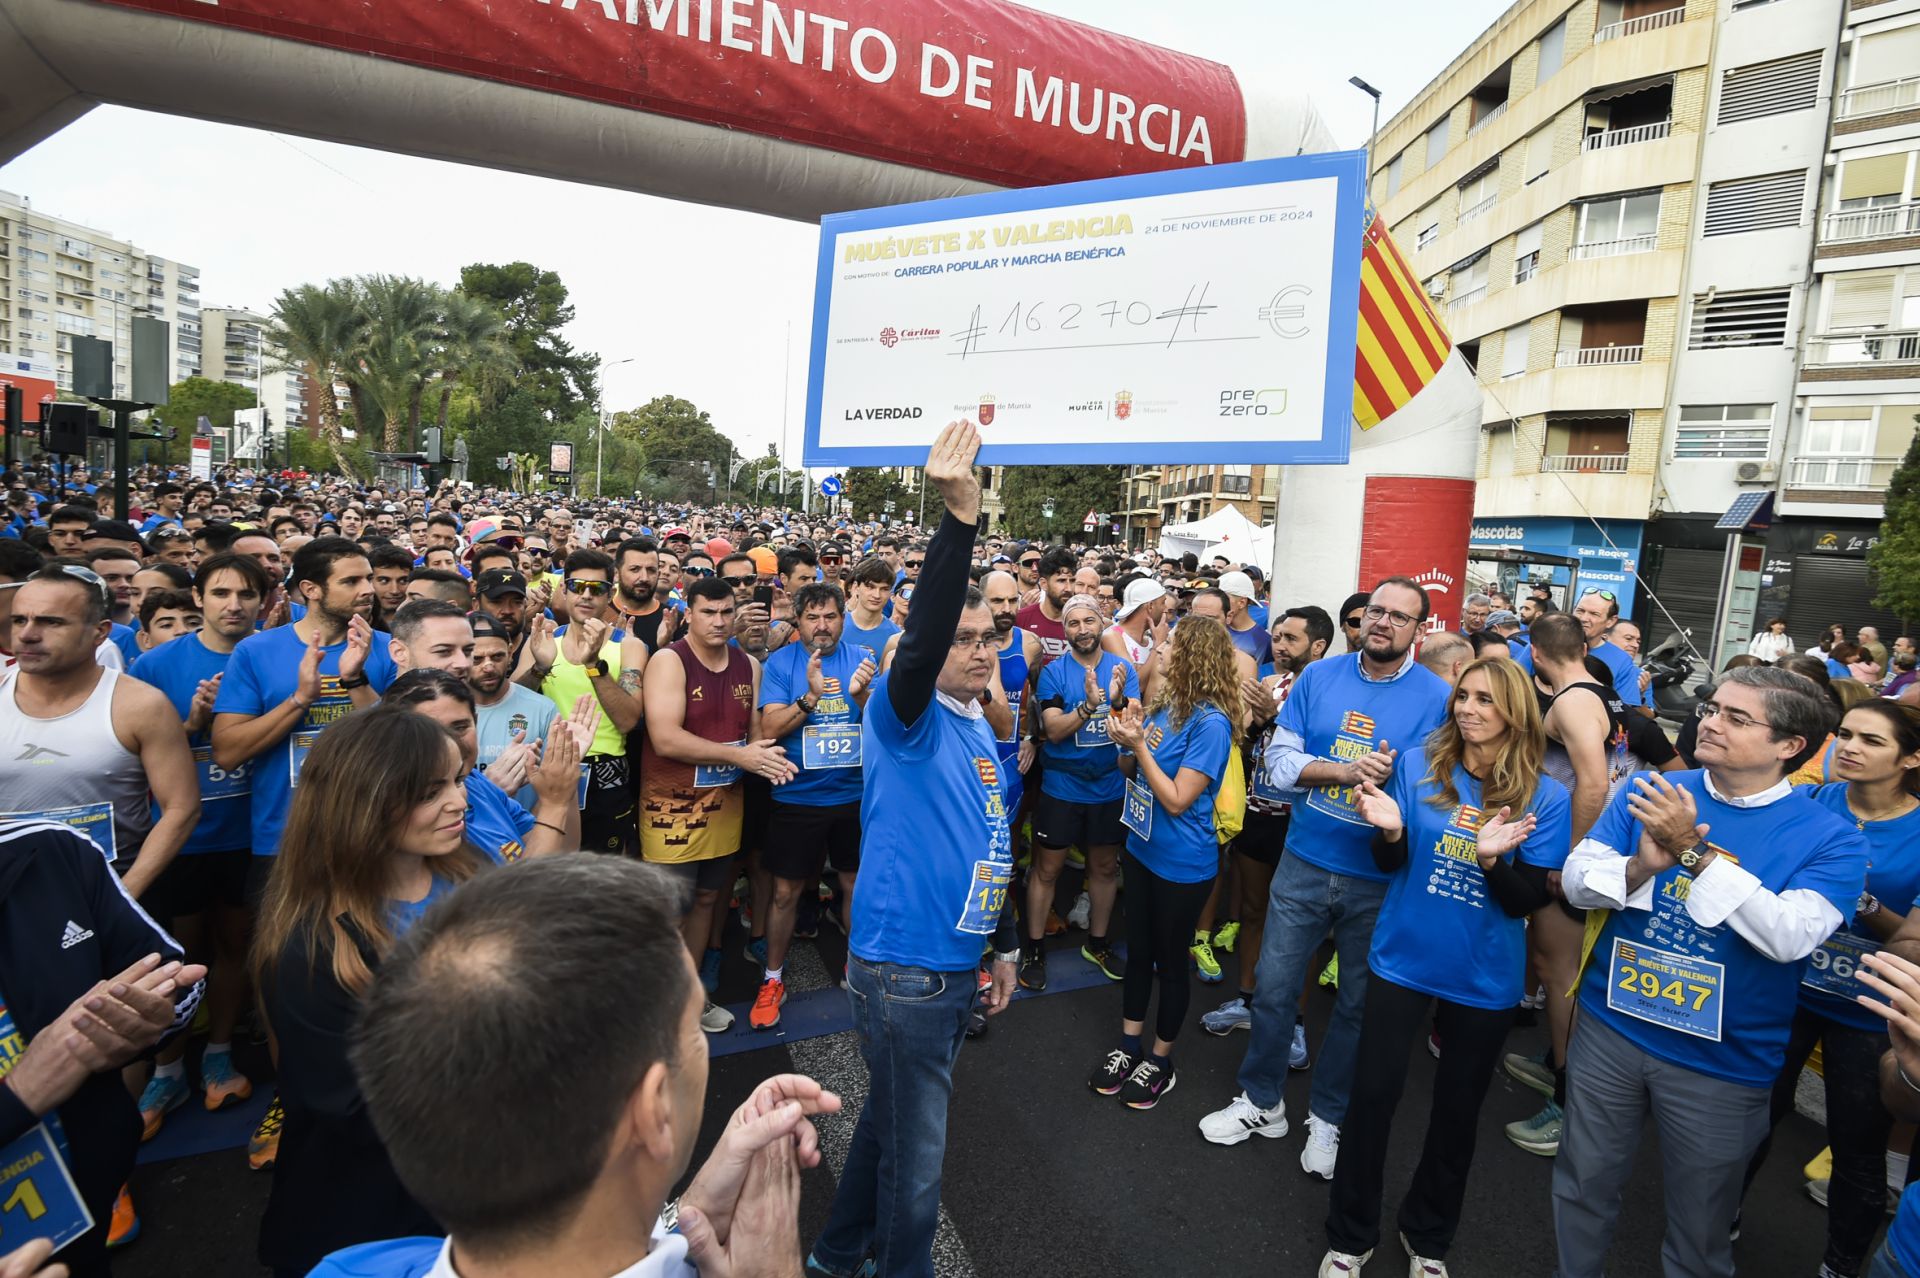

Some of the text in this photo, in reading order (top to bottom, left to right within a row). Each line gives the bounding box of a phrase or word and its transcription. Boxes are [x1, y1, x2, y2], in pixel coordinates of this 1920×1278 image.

[920, 42, 994, 110] DE
[1014, 67, 1214, 164] MURCIA
[1145, 210, 1313, 235] 24 DE NOVIEMBRE DE 2024
[844, 214, 1134, 263] MUÉVETE X VALENCIA
[894, 246, 1126, 278] CARRERA POPULAR Y MARCHA BENÉFICA
[900, 327, 941, 338] Cáritas
[1219, 390, 1255, 404] pre
[845, 407, 923, 421] LA VERDAD
[953, 404, 977, 412] Región
[1007, 402, 1032, 410] Murcia
[1219, 404, 1268, 416] zero
[1470, 525, 1524, 540] Mascotas
[1578, 548, 1629, 559] San Roque
[1577, 571, 1625, 582] Mascotas
[1085, 720, 1108, 734] 45
[815, 738, 852, 755] 192
[1257, 770, 1273, 787] 10
[1129, 797, 1146, 822] 935
[69, 813, 108, 825] VALENCIA
[1441, 833, 1478, 853] MUÉVE
[1433, 841, 1443, 853] X
[1444, 844, 1479, 864] VALEN
[1671, 966, 1677, 976] X
[1678, 969, 1717, 985] VALENCIA
[1618, 965, 1713, 1012] 2947
[0, 1150, 45, 1185] ENCIA
